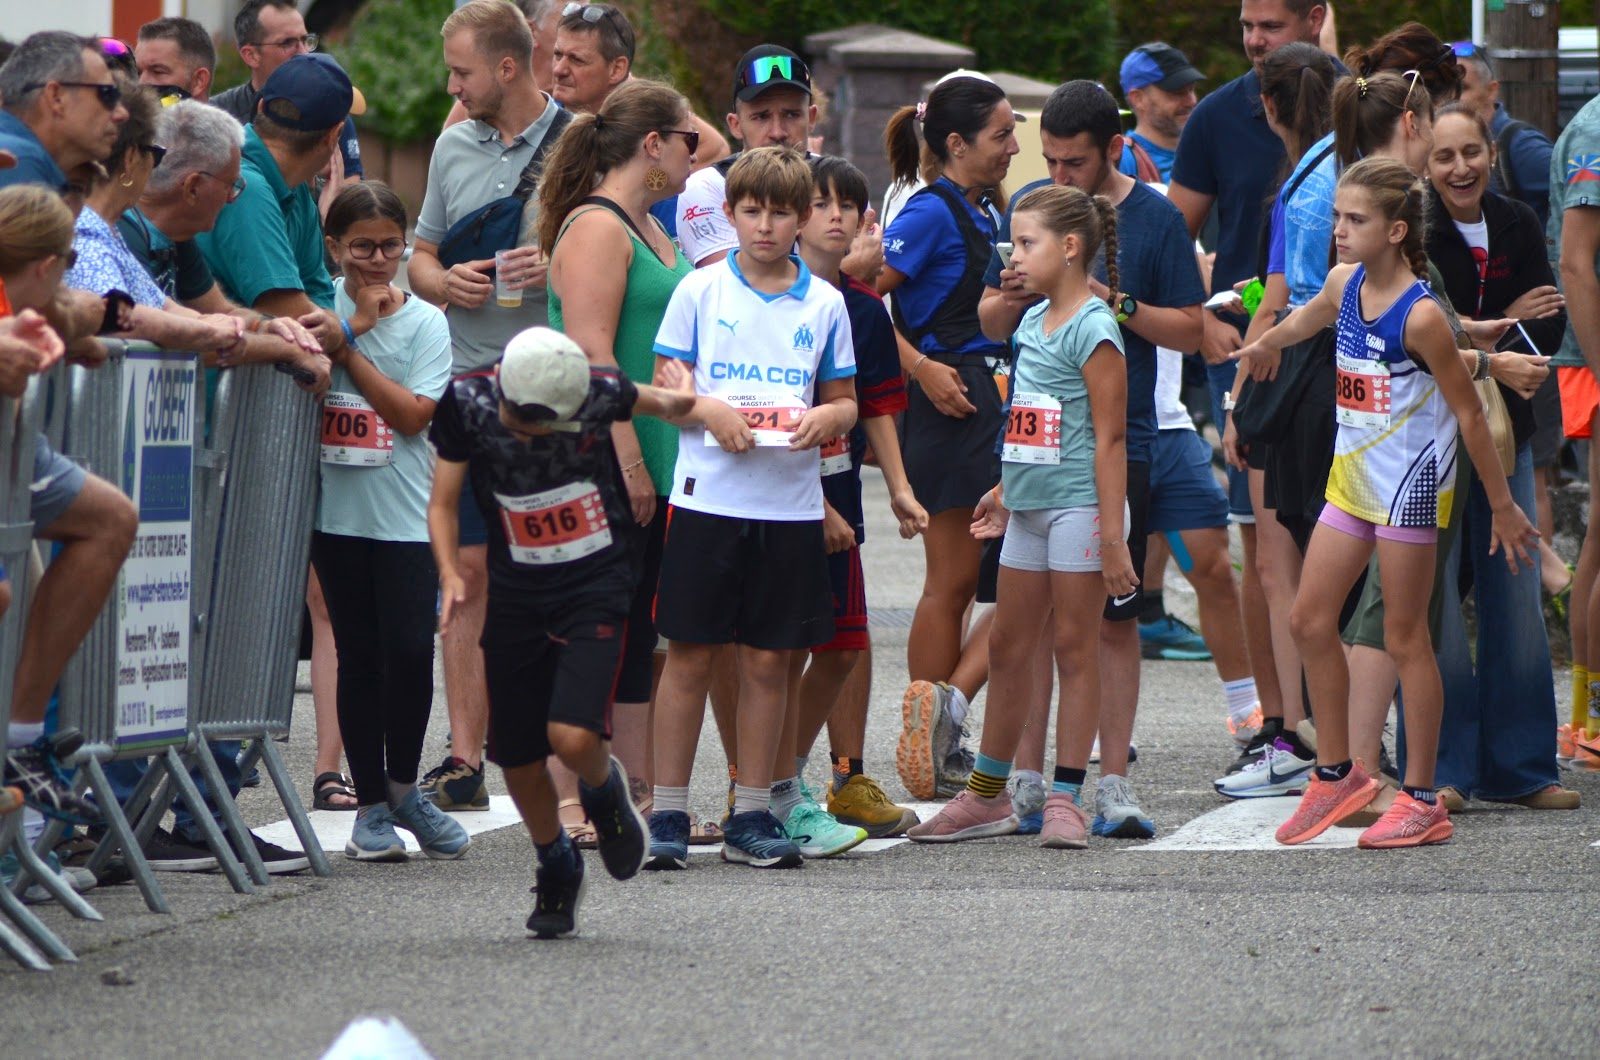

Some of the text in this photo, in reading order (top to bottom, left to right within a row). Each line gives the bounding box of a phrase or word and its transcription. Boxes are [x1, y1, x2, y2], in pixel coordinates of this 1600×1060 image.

[1366, 333, 1385, 352] EGMA
[710, 362, 763, 382] CMA
[144, 367, 194, 442] GOBERT
[329, 400, 362, 408] MAGSTATT
[325, 412, 368, 439] 706
[524, 507, 578, 539] 616
